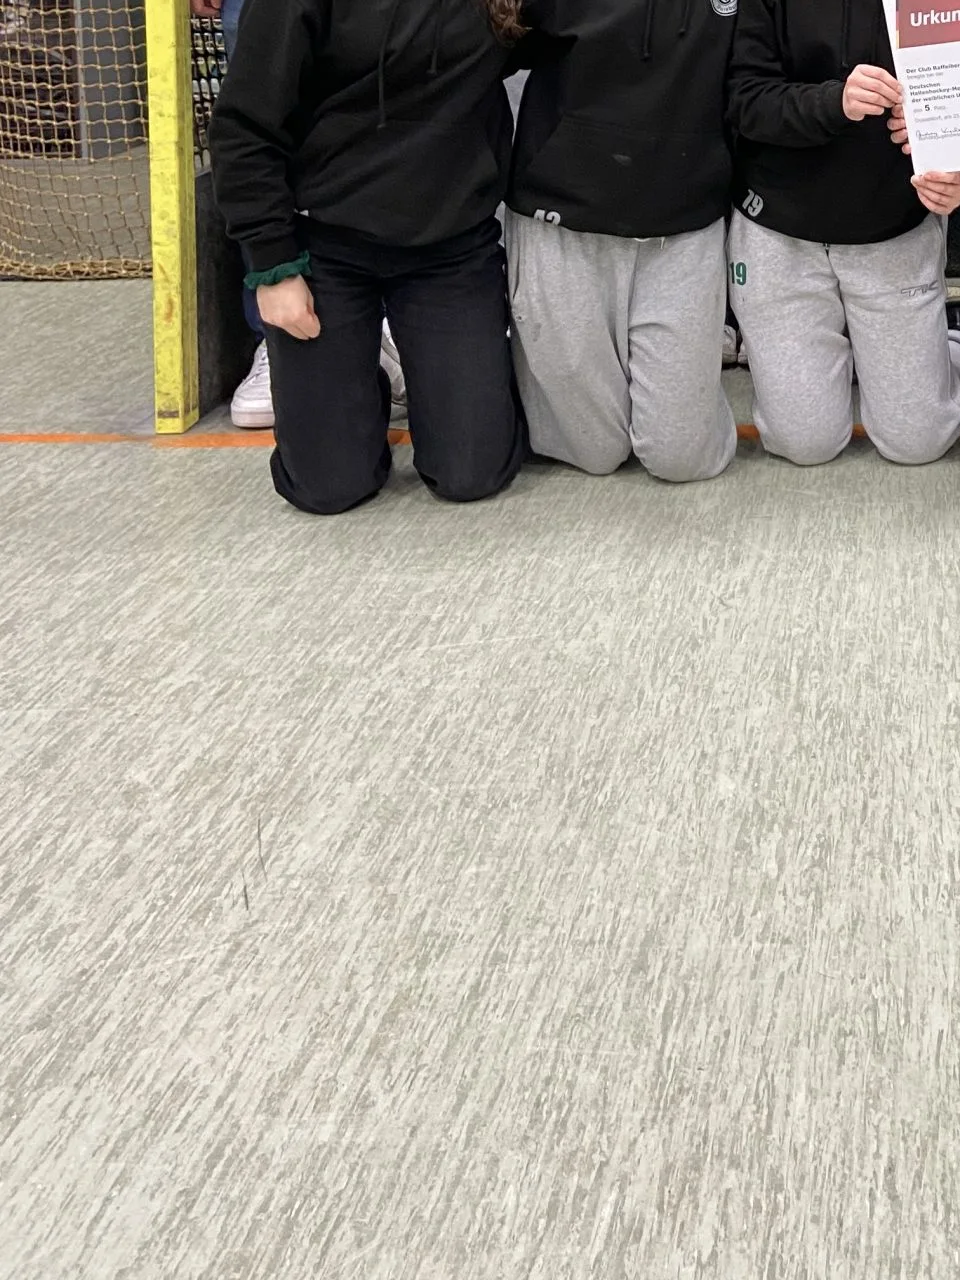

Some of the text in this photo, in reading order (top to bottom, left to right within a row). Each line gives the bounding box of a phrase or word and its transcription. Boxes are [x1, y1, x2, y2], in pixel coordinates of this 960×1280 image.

[909, 82, 941, 90] Deutschen
[923, 93, 955, 102] weiblichen
[742, 188, 764, 217] 19
[730, 261, 747, 286] 19
